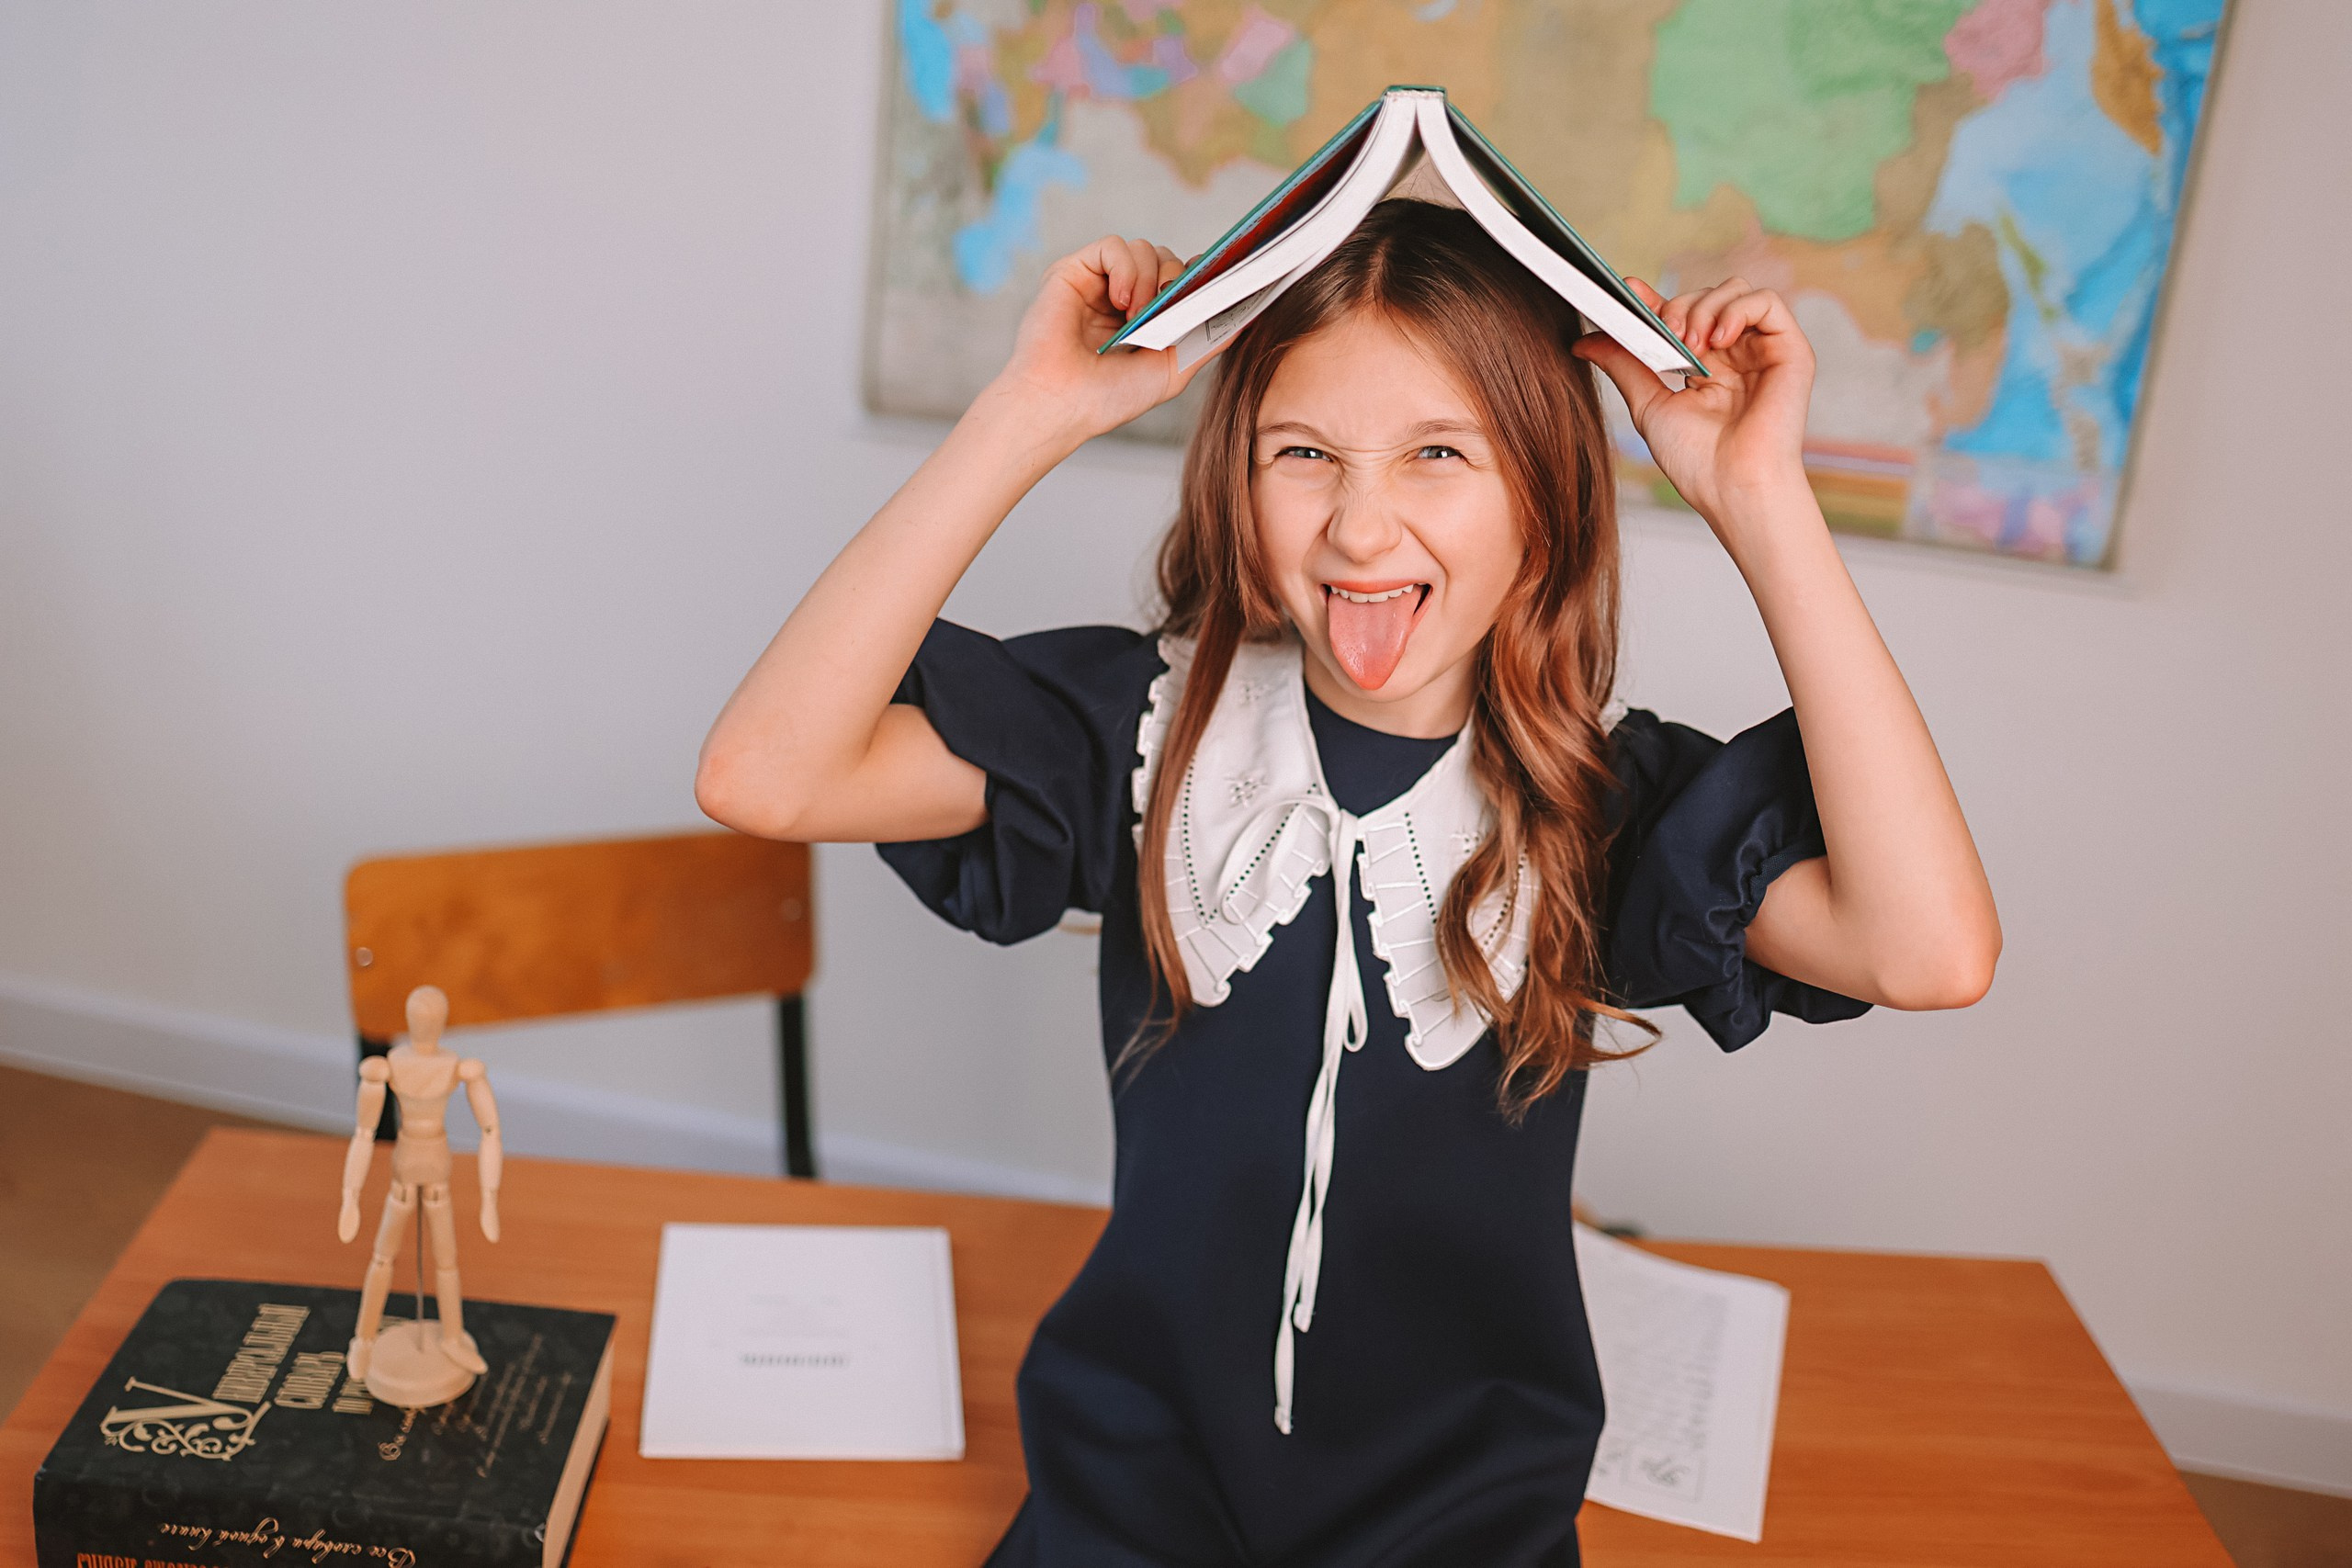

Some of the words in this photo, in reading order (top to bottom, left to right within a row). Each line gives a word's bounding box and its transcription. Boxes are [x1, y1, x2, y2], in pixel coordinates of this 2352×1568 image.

[275, 1351, 346, 1409] СЛОВАРЬ
[159, 1523, 212, 1551] книге
[212, 1517, 279, 1546] одной
[263, 1535, 286, 1559] в
[292, 1529, 362, 1564] словари
[368, 1546, 415, 1568] Все
